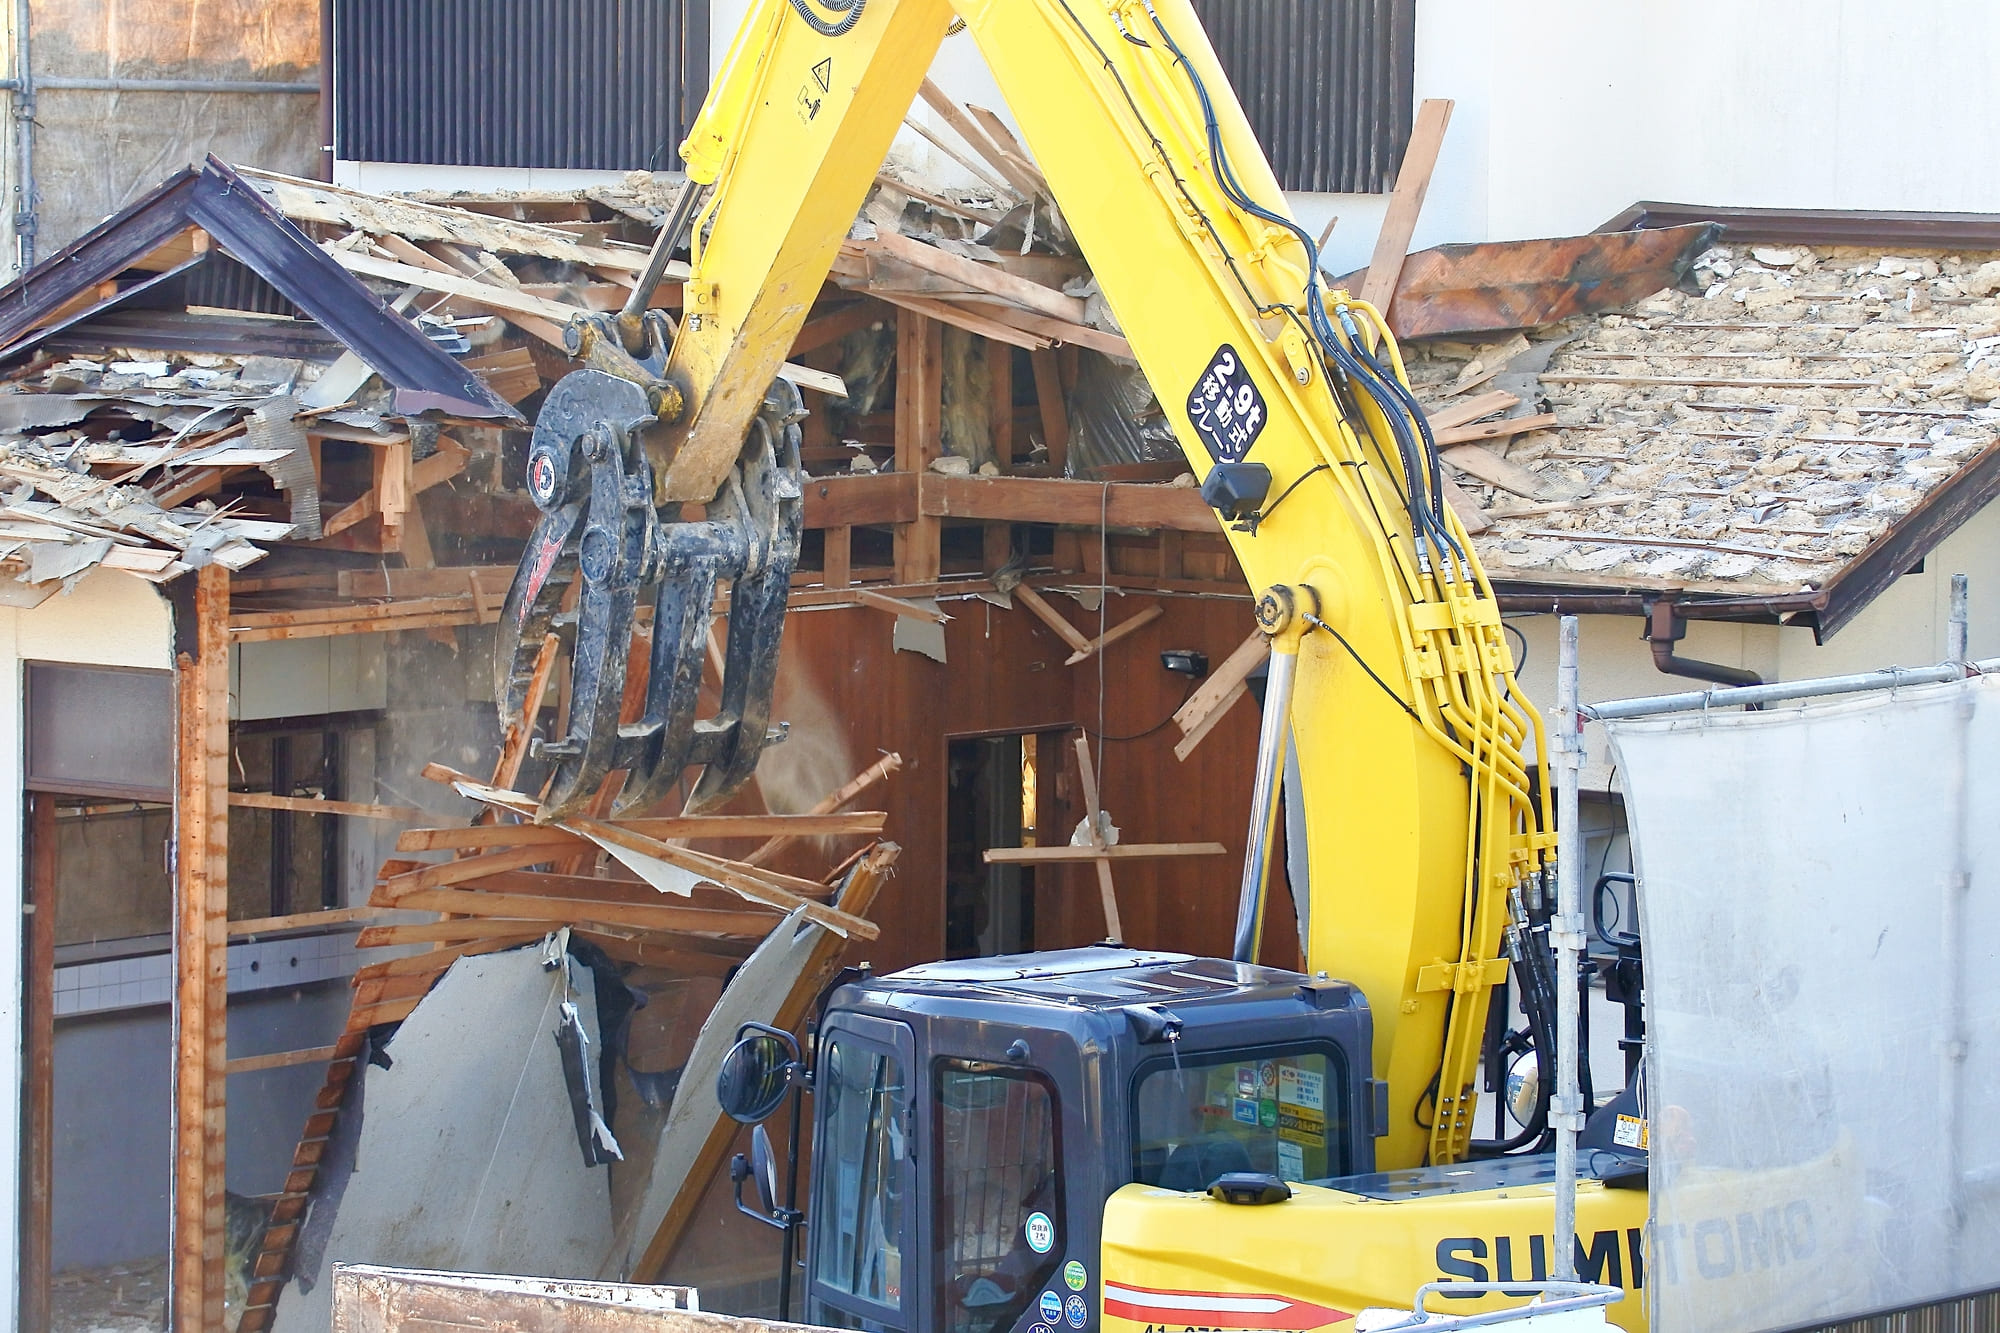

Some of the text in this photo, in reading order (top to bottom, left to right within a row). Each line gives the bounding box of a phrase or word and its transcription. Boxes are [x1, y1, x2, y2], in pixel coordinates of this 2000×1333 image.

[1190, 396, 1235, 464] クレーン
[1202, 373, 1248, 452] 移動式
[1213, 352, 1261, 435] 2.9t
